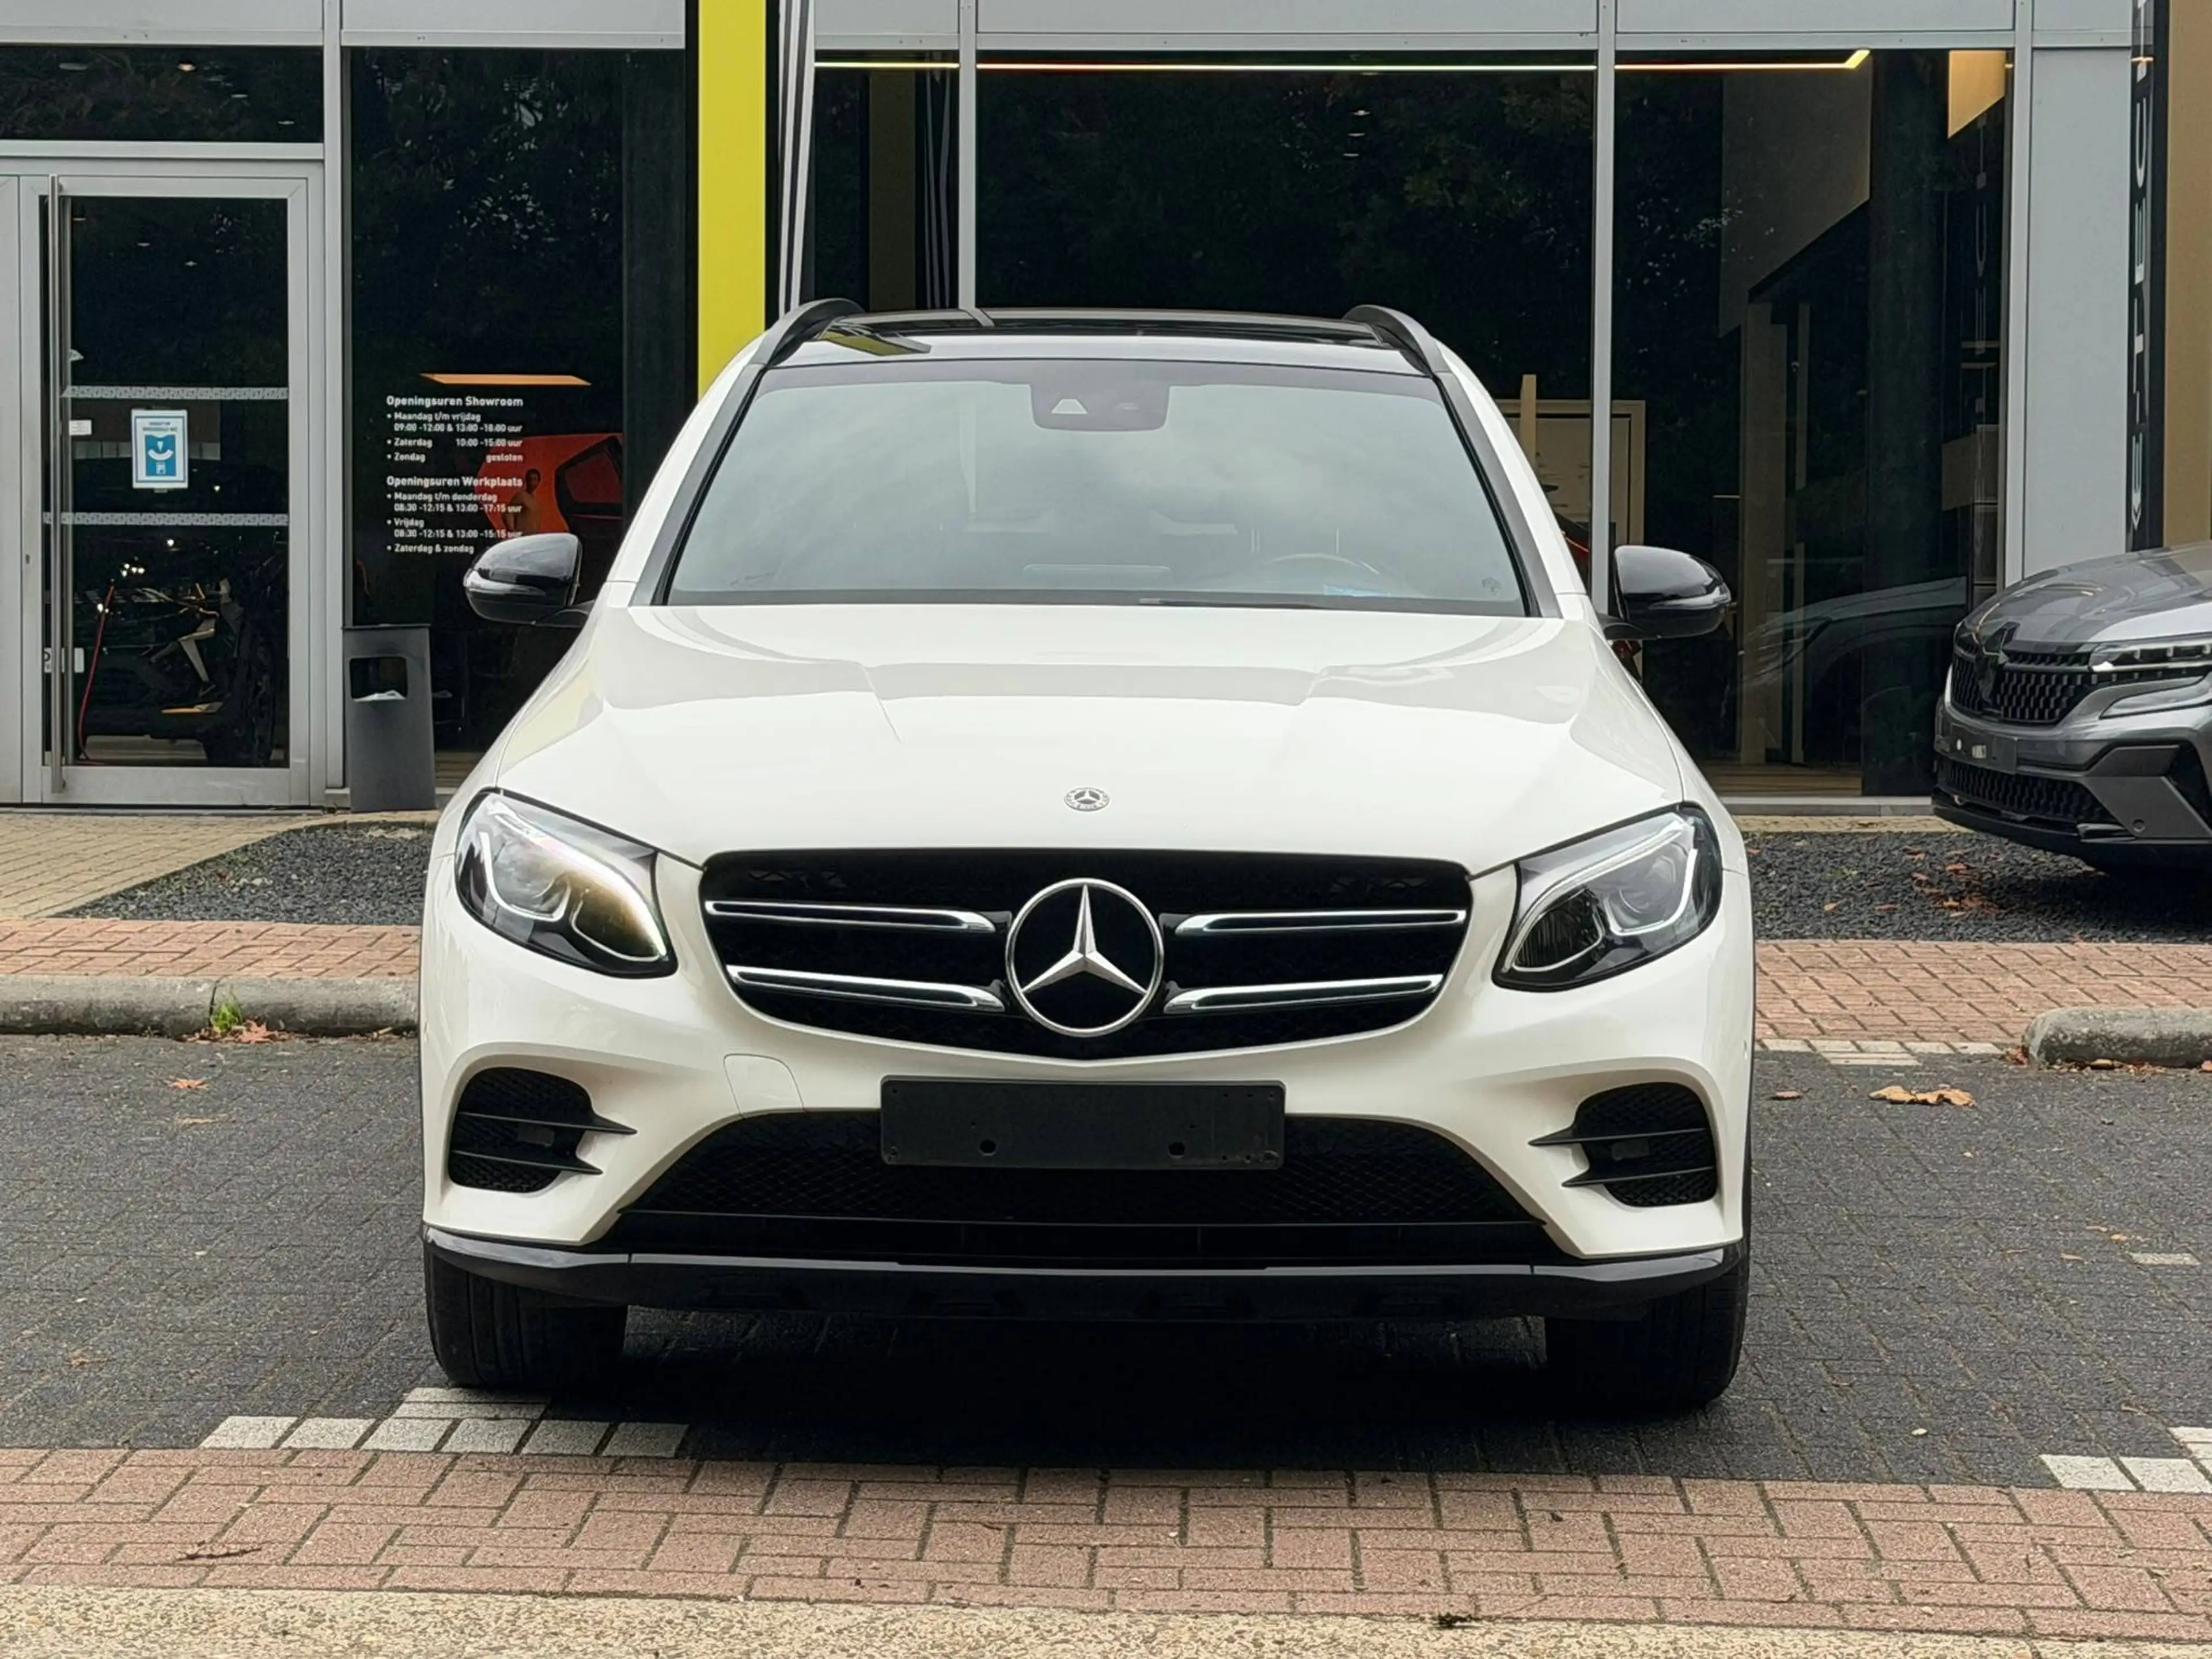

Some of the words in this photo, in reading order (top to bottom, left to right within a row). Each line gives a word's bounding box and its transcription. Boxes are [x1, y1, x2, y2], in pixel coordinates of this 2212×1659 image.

[387, 395, 463, 408] Openingsuren
[465, 396, 524, 407] Showroom
[394, 412, 433, 422] Maandag
[434, 412, 450, 421] t/m
[451, 412, 481, 423] vrijdag
[446, 423, 454, 432] &
[394, 437, 433, 449] Zaterdag
[456, 438, 479, 447] 10:00
[394, 452, 426, 463] Zondag
[486, 453, 524, 463] gesloten
[387, 475, 460, 488] Openingsuren
[461, 476, 523, 488] Werkplaats
[394, 492, 433, 502] Maandag
[434, 492, 450, 501] t/m
[452, 493, 498, 503] donderdag
[446, 503, 454, 512] &
[507, 505, 523, 513] uur
[394, 517, 425, 528] Vrijdag
[446, 529, 454, 538] &
[395, 543, 433, 555] Zaterdag
[435, 543, 442, 553] &
[443, 544, 474, 555] zondag
